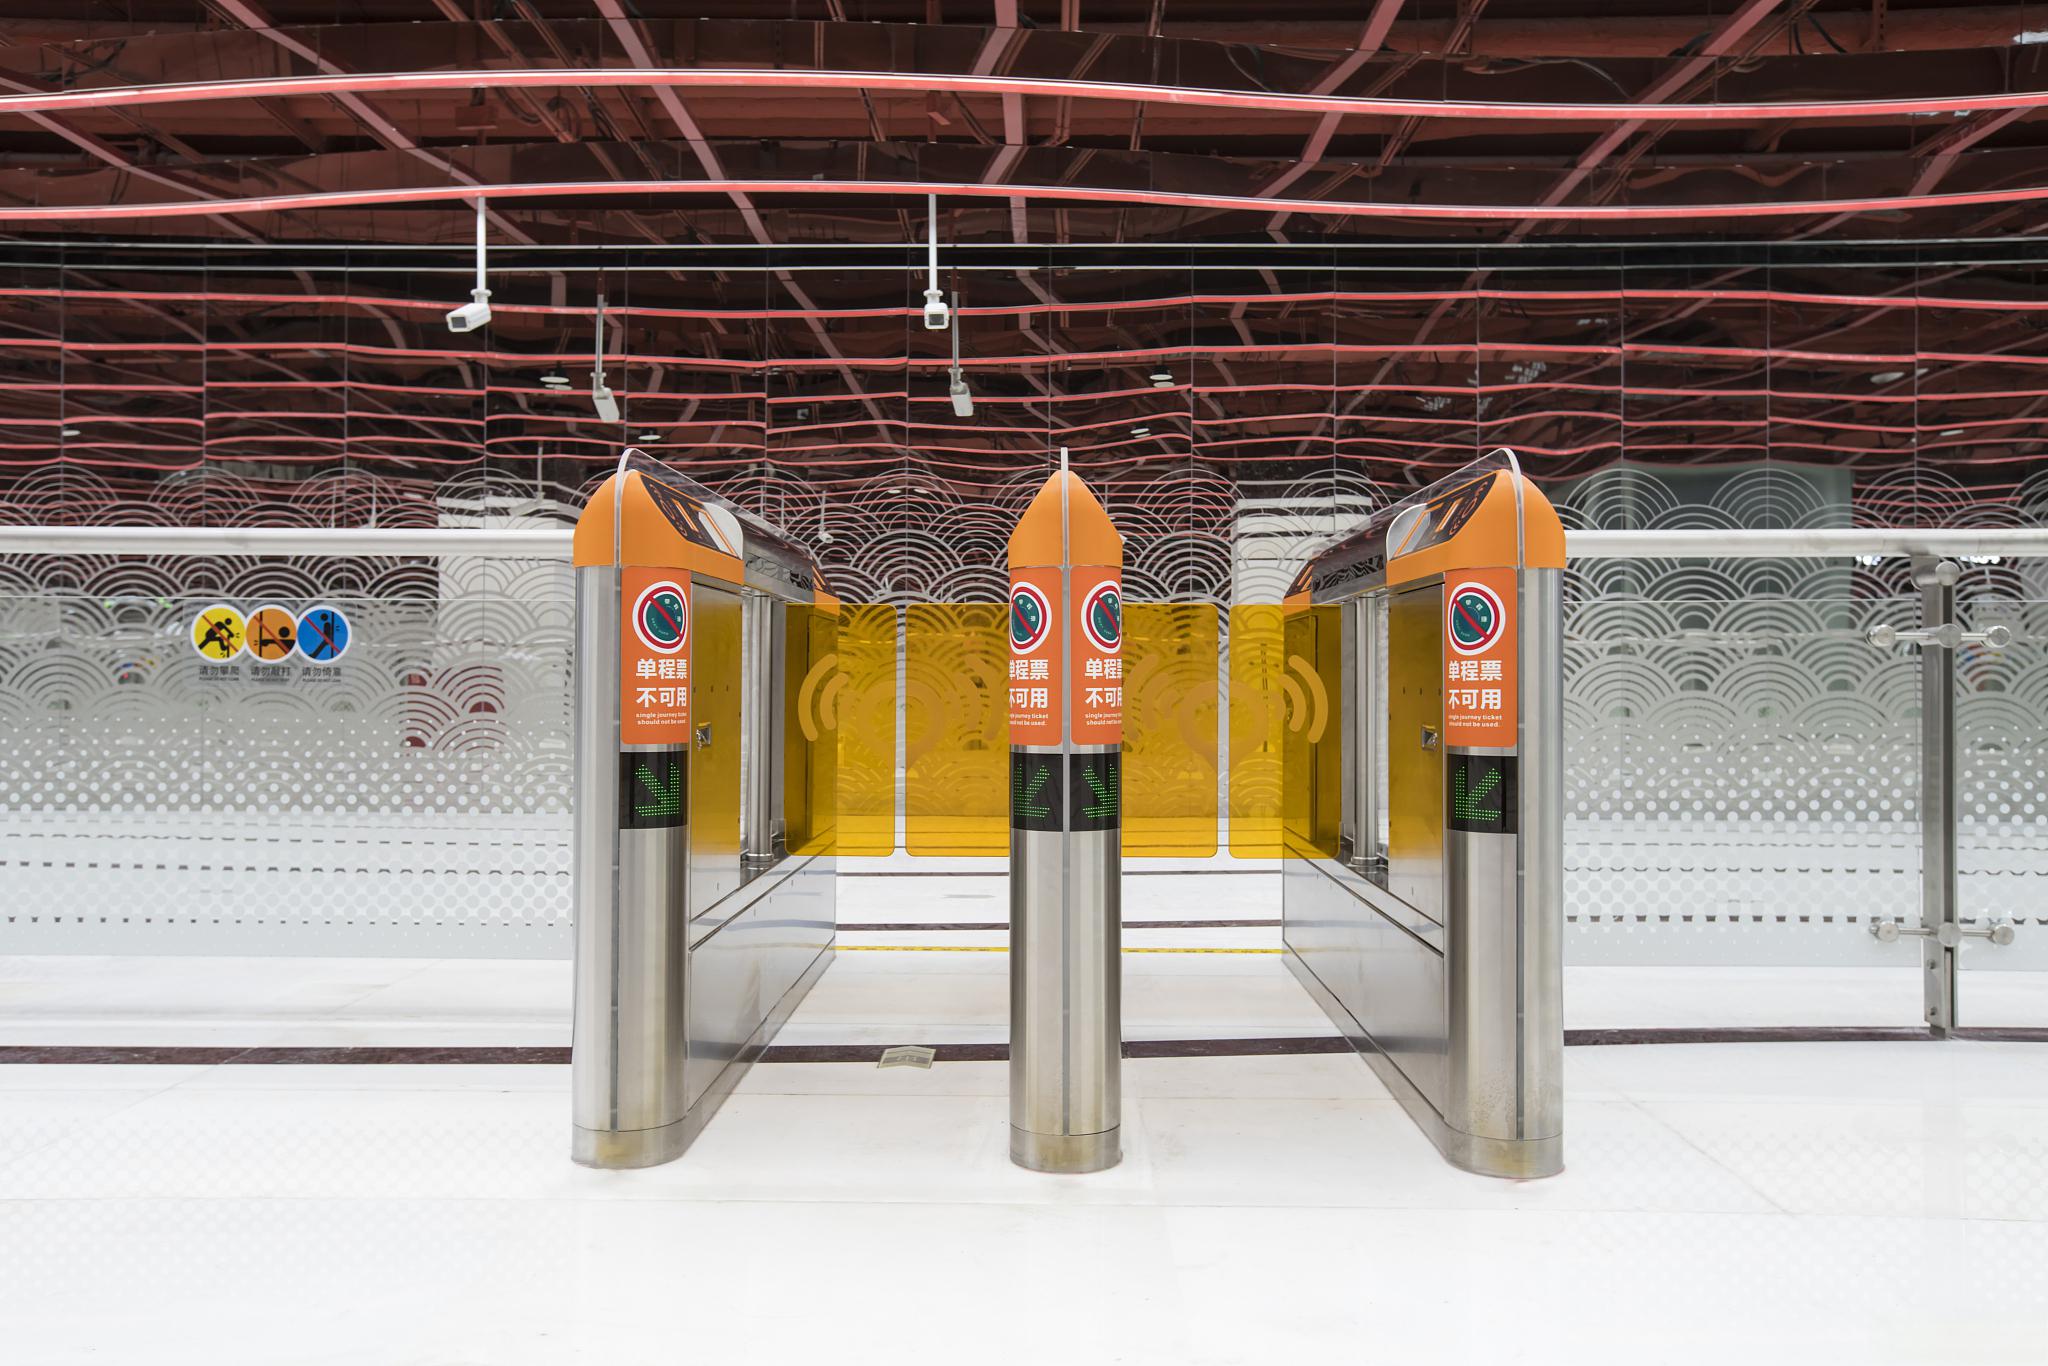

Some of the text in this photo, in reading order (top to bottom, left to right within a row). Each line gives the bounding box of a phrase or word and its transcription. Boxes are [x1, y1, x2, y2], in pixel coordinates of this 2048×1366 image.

[636, 658, 687, 680] 单程票
[1448, 660, 1503, 681] 单程票
[636, 687, 687, 708] 不可用
[1448, 689, 1502, 710] 不可用
